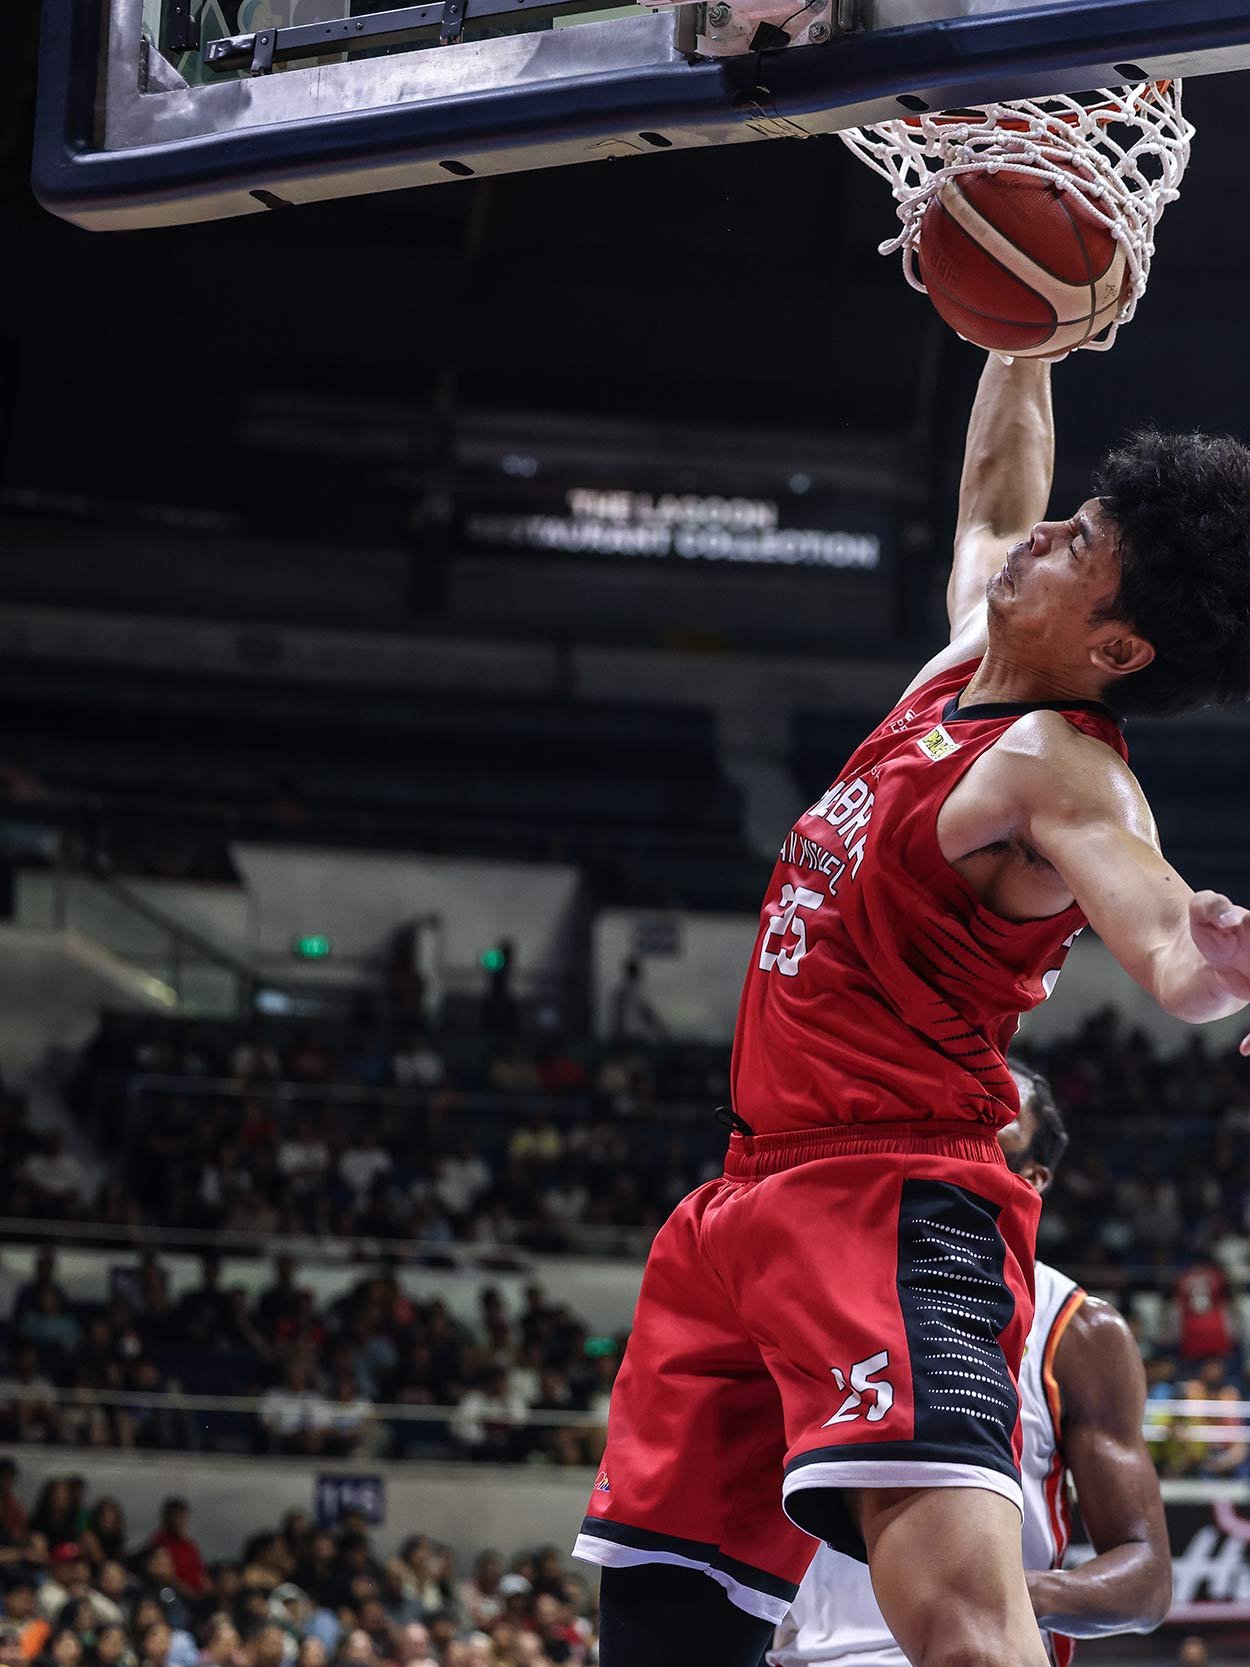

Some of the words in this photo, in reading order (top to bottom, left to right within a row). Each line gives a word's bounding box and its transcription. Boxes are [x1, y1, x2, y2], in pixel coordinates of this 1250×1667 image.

[567, 488, 633, 523] THE
[466, 512, 672, 558] TAURANT
[674, 527, 881, 571] COLLECTION
[759, 883, 824, 976] 25
[821, 1349, 894, 1428] 25
